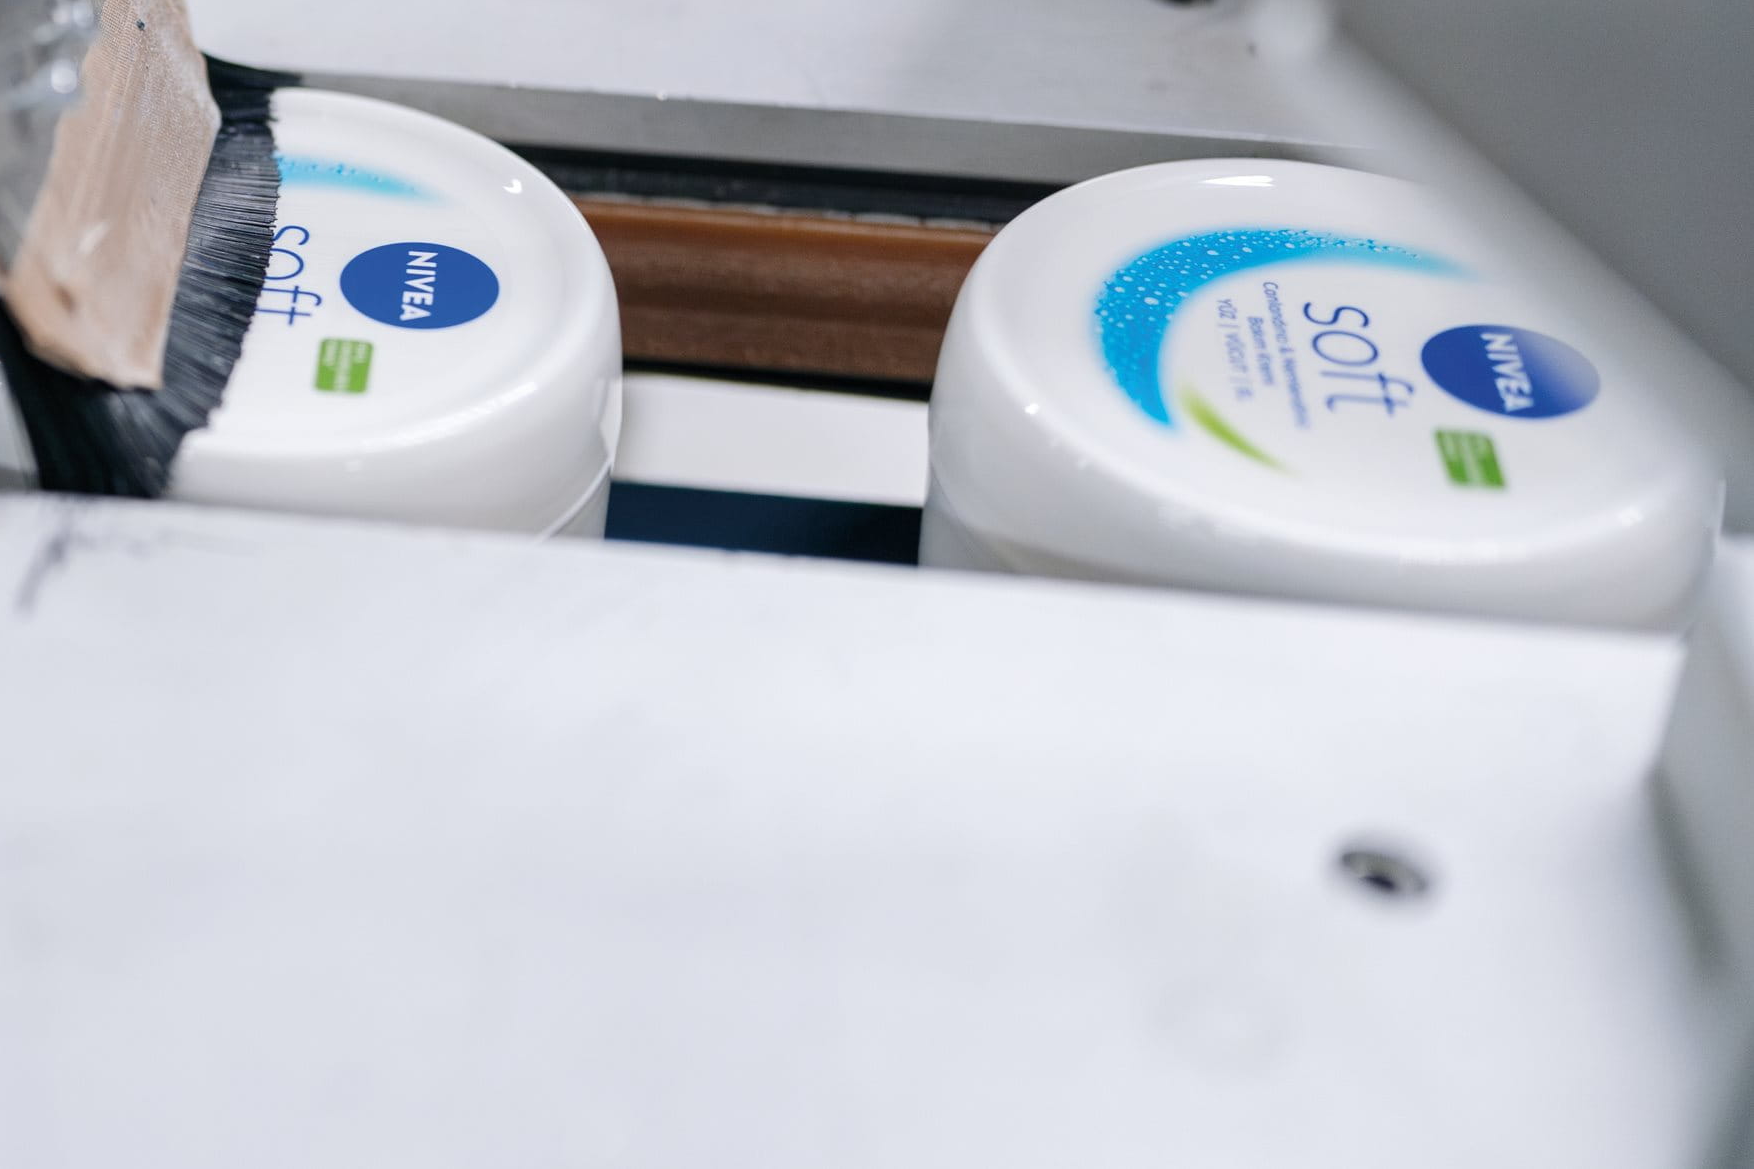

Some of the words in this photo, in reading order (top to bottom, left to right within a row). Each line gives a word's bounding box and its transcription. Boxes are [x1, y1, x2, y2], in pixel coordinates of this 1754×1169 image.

[399, 250, 438, 321] NIVEA
[1303, 302, 1414, 416] soft
[1480, 333, 1534, 412] NIVEA
